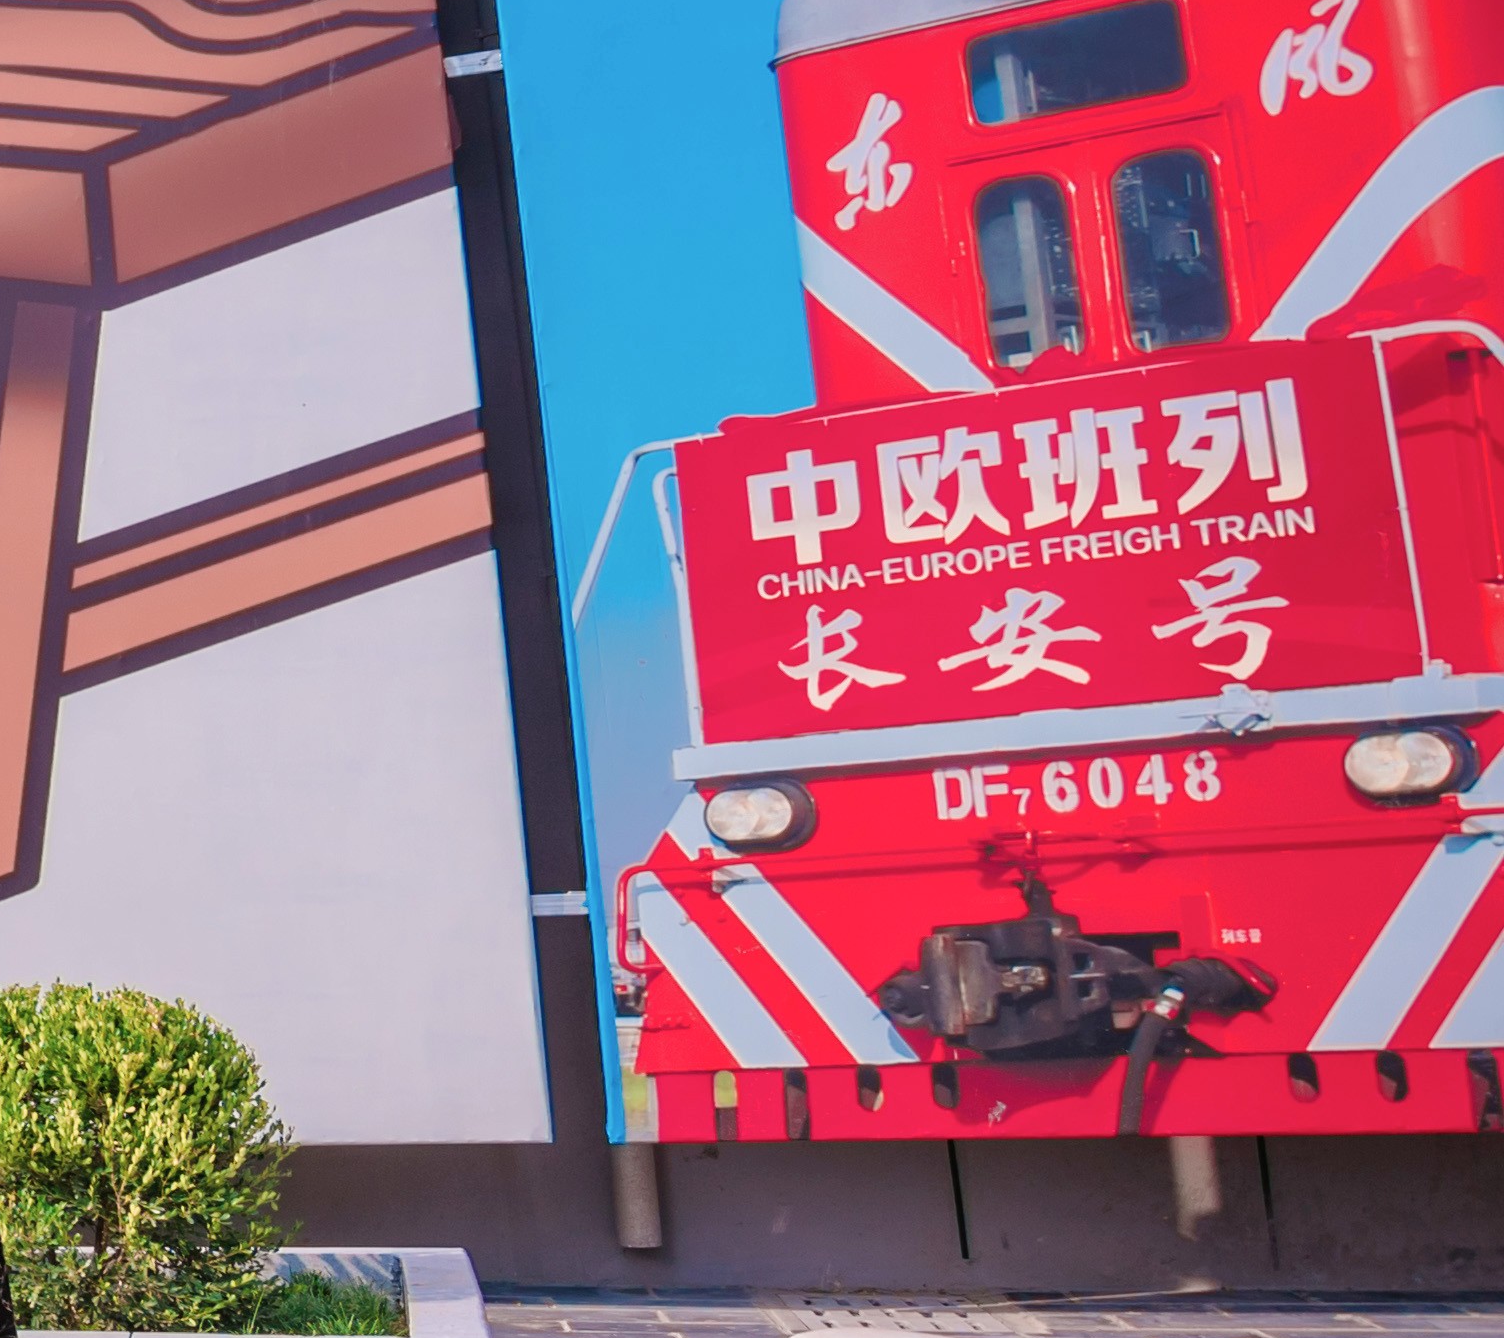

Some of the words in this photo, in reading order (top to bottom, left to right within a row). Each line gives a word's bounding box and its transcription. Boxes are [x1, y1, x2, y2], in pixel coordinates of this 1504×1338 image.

[745, 377, 1309, 566] 中欧班列
[756, 542, 1031, 600] CHINA-EUROPE
[1041, 523, 1181, 567] FREIGH
[1184, 506, 1316, 547] TRAIN
[777, 556, 1289, 710] 长安号
